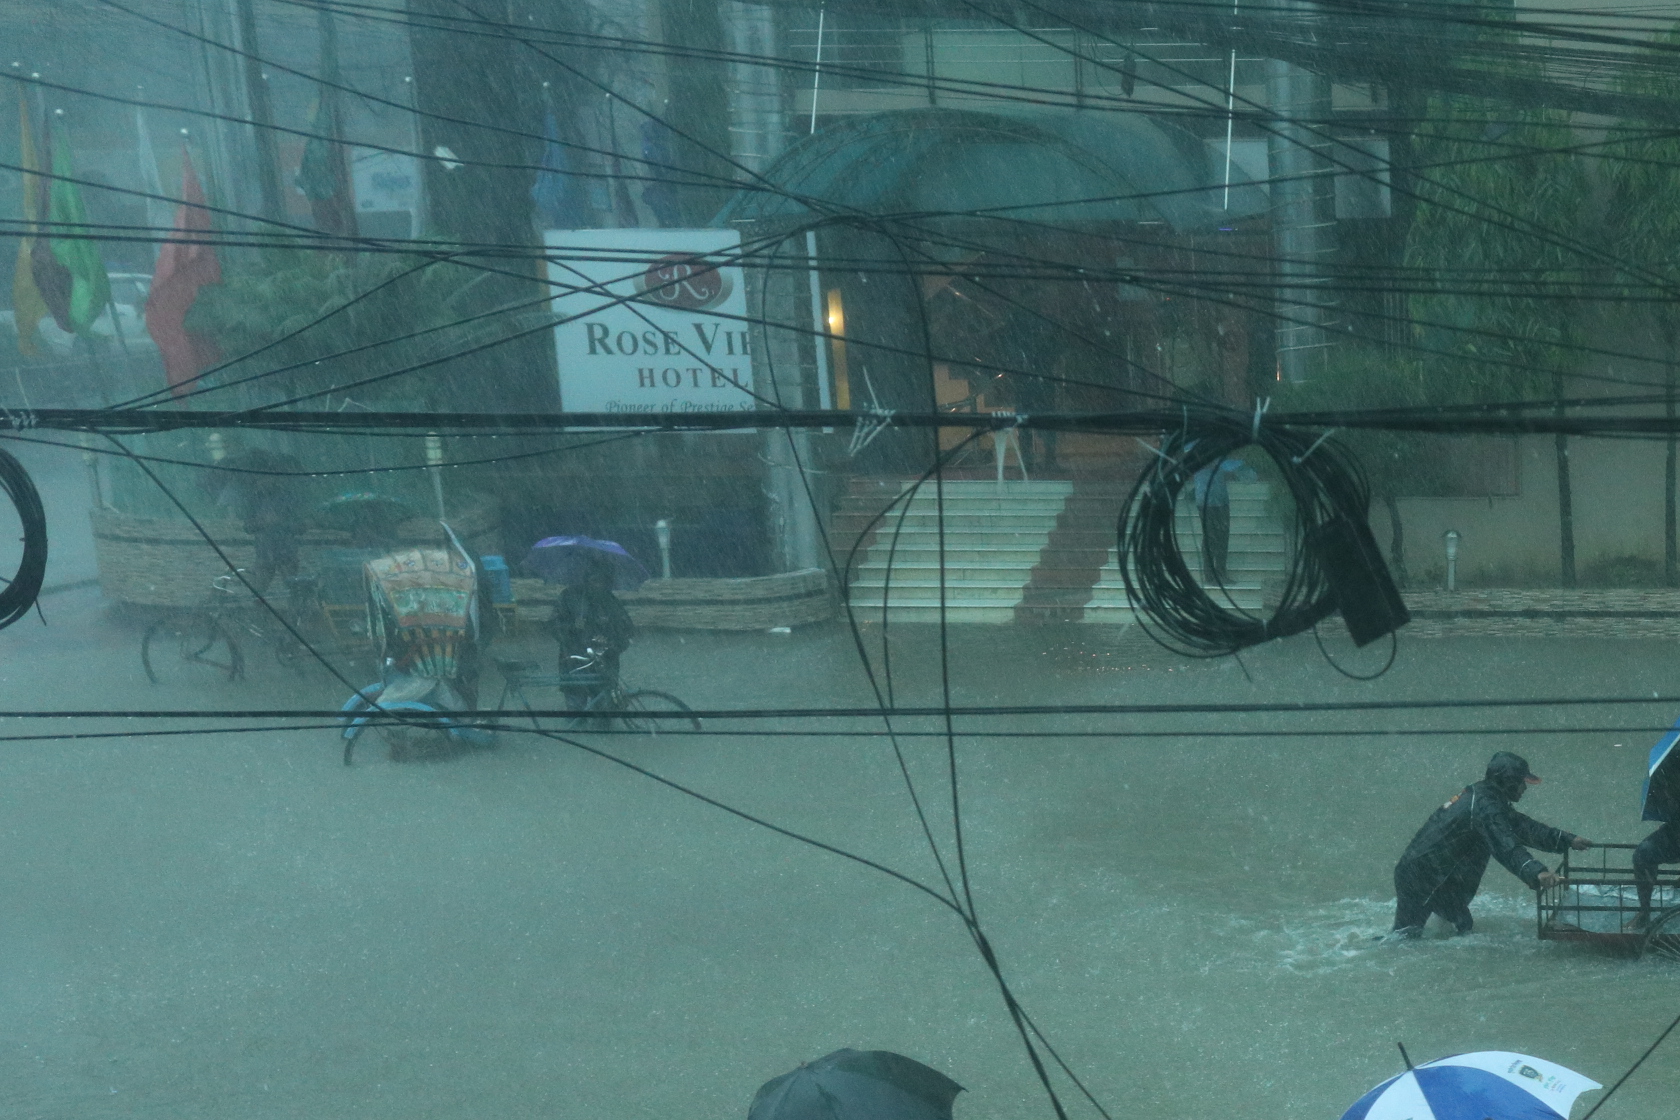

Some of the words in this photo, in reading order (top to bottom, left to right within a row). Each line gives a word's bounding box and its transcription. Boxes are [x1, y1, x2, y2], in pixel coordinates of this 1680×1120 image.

[584, 322, 682, 356] ROSE
[637, 367, 749, 388] HOTEL
[605, 400, 656, 413] Pioneer
[661, 398, 677, 413] of
